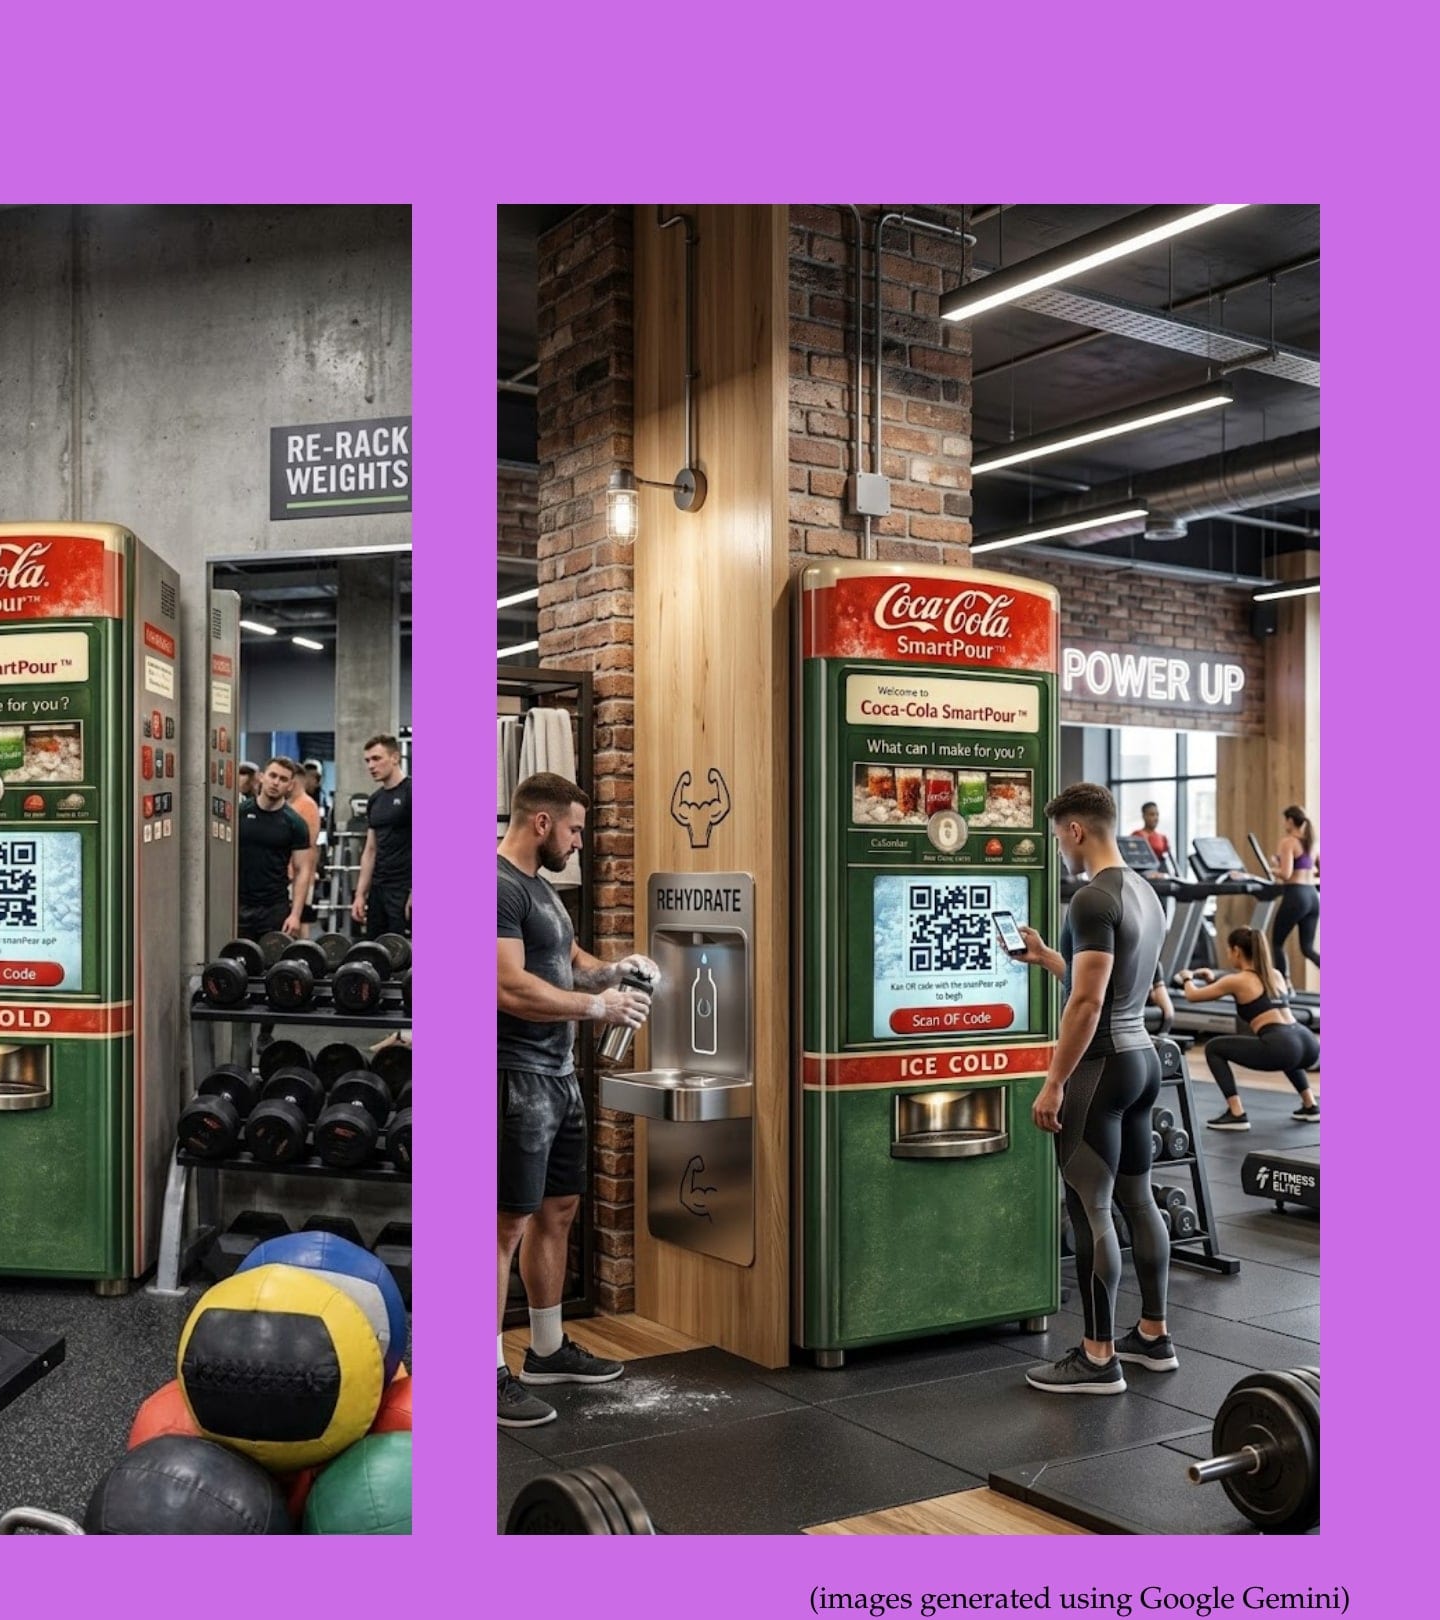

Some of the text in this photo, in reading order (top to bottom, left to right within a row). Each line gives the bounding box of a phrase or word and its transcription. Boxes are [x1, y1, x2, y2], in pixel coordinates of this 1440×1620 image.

[287, 426, 409, 463] RE-RACK
[286, 459, 409, 495] WEIGHTS
[1062, 648, 1245, 705] POWER UP
[878, 686, 929, 697] Welcome to
[7, 699, 28, 712] for
[861, 700, 938, 719] Coca-Cola
[867, 739, 902, 754] What
[905, 743, 927, 755] can
[939, 743, 971, 757] make
[974, 744, 991, 757] for
[657, 888, 741, 912] REHYDRATE
[3, 968, 36, 980] Code
[913, 1012, 991, 1027] Scan OF Code
[900, 1053, 1008, 1076] ICE COLD
[1273, 1171, 1315, 1187] FITNESS
[1273, 1181, 1301, 1196] ELITE
